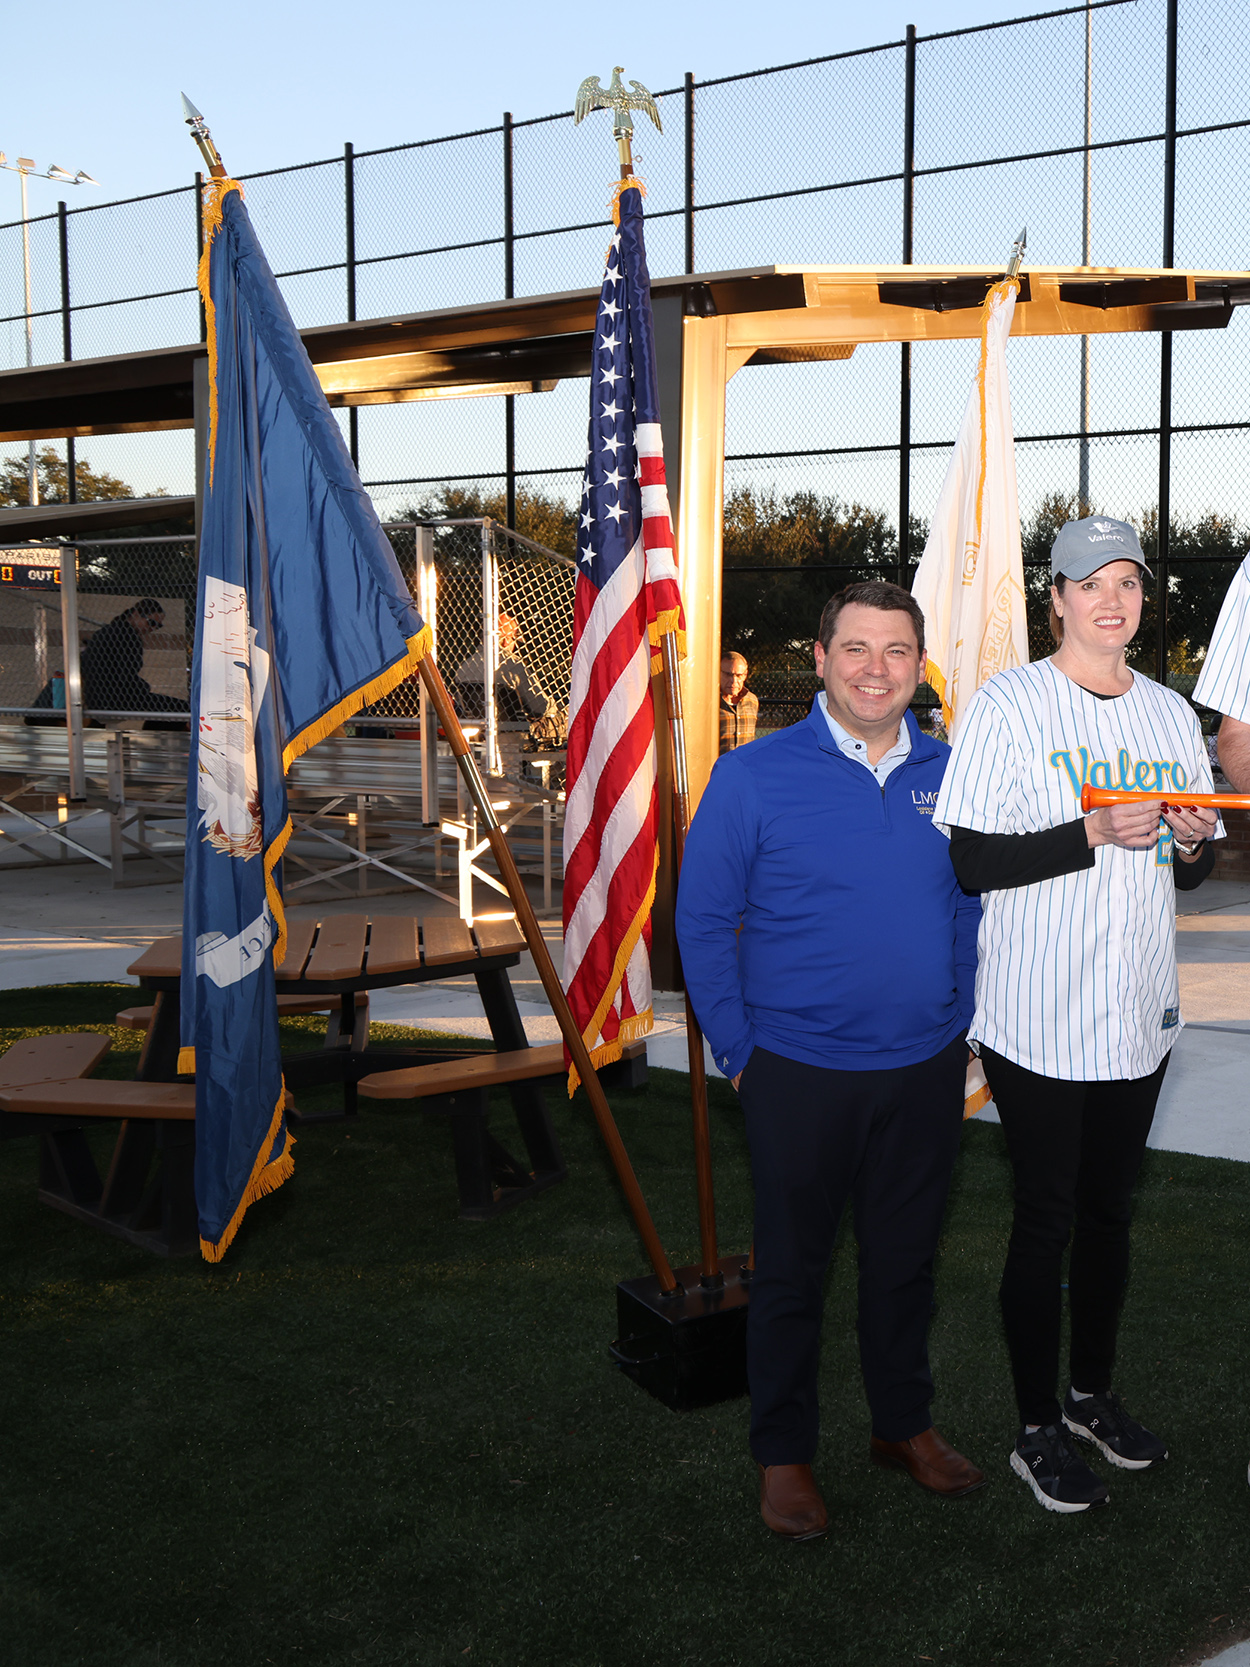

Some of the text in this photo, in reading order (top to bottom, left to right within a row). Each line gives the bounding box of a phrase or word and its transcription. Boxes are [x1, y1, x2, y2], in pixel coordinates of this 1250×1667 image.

[1088, 533, 1124, 543] Valero
[28, 569, 52, 581] OUT
[1049, 745, 1188, 800] Valero
